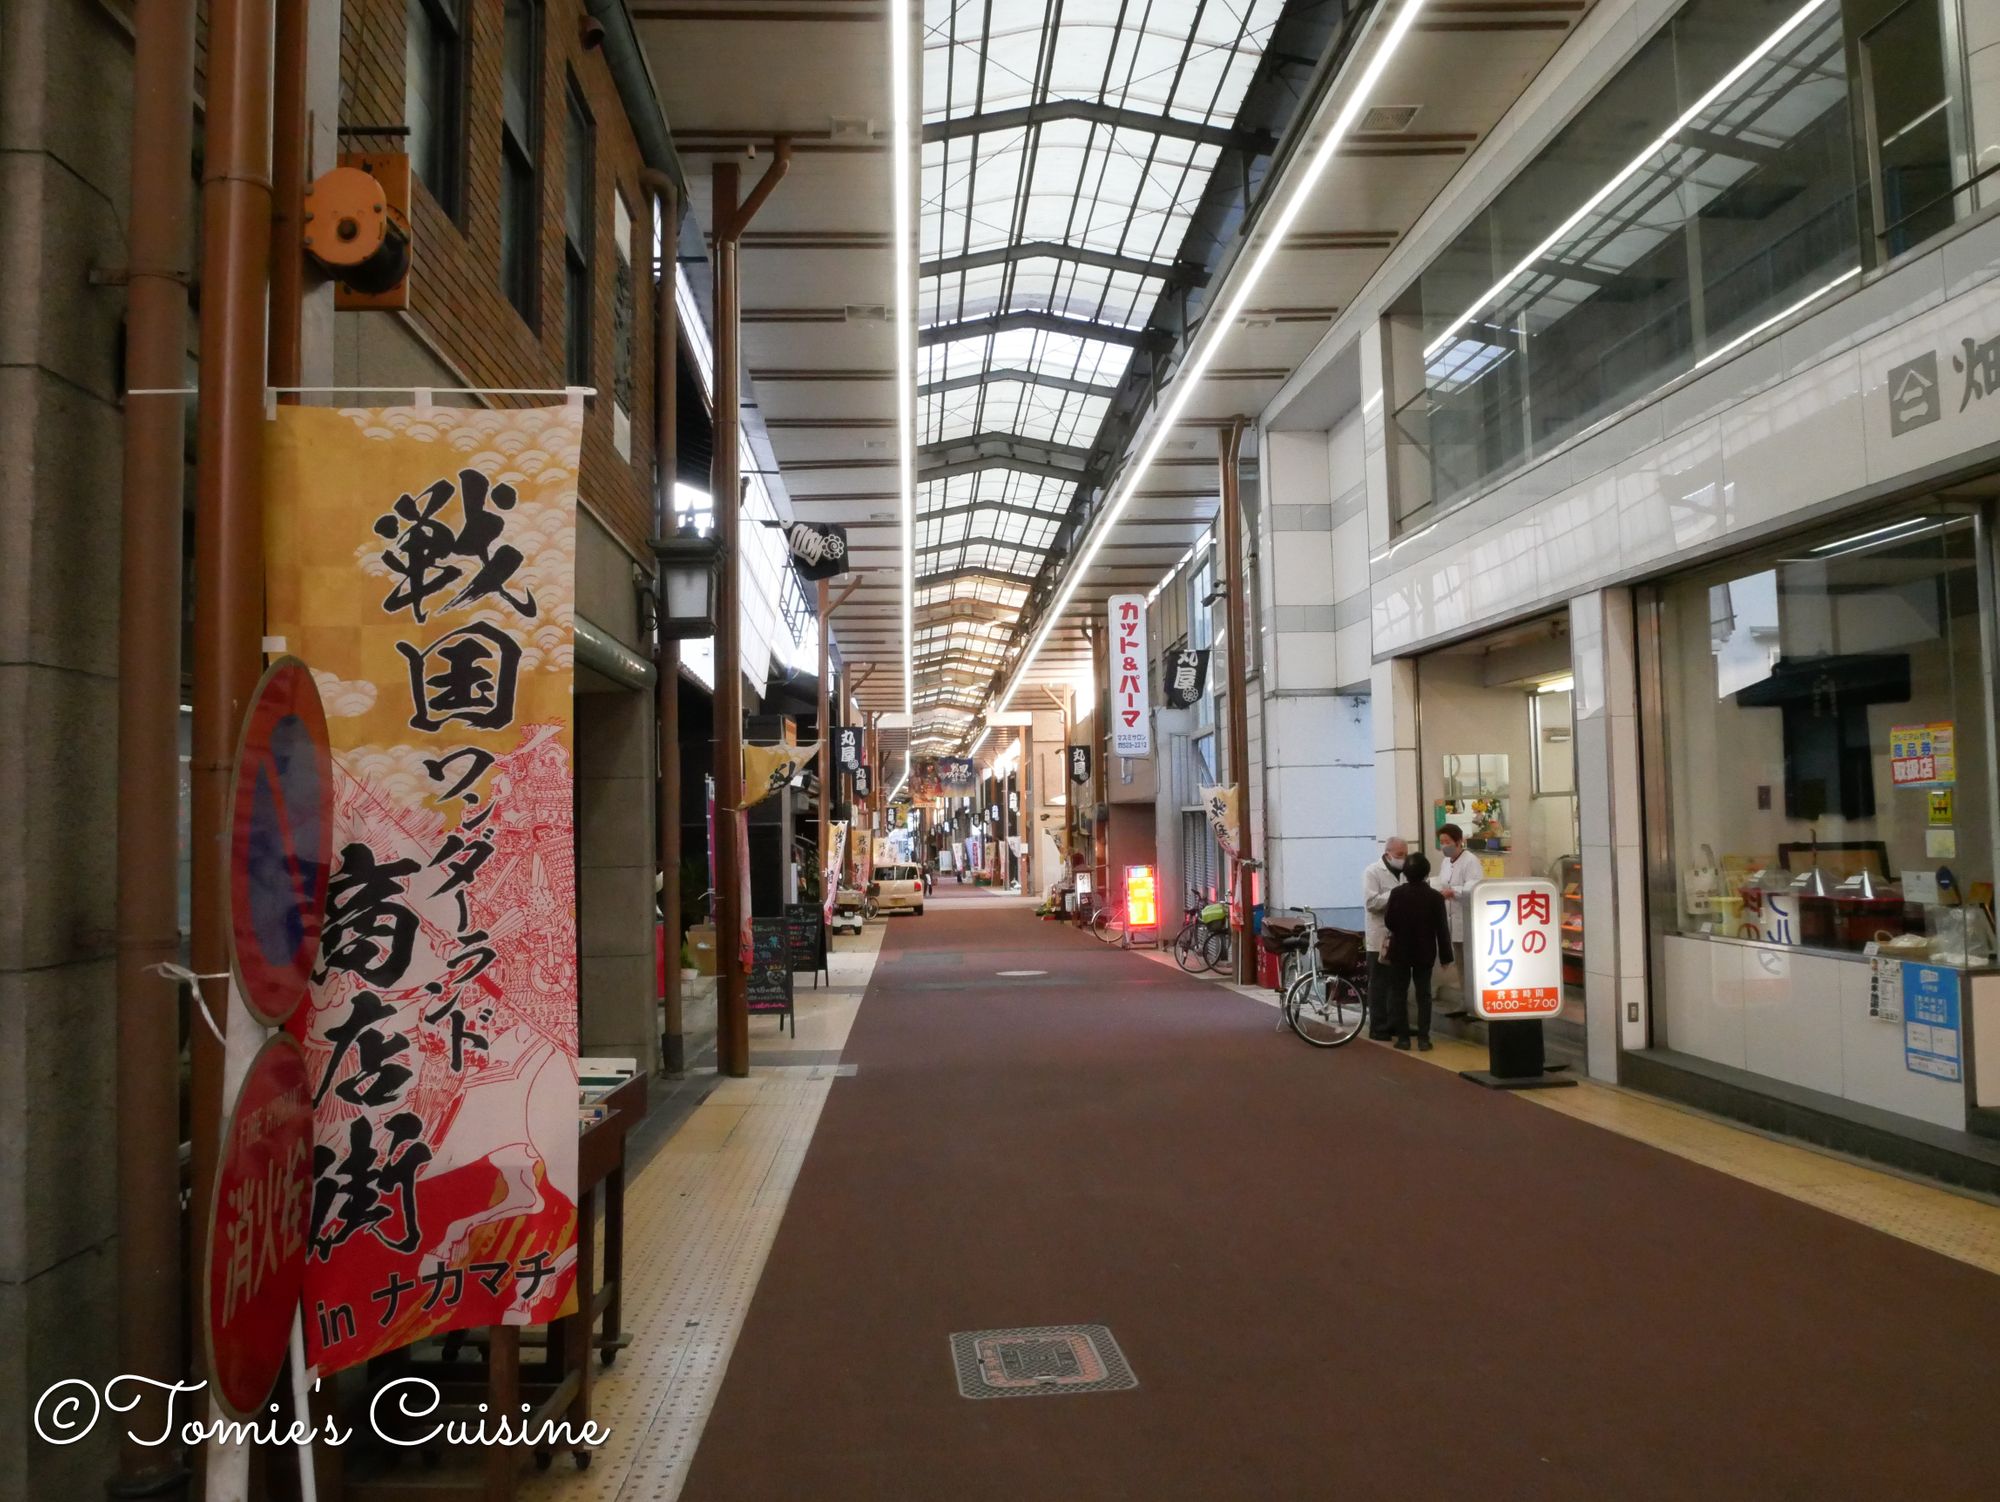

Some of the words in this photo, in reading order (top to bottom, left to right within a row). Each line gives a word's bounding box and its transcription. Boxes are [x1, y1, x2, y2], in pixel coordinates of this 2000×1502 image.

[1485, 898, 1515, 987] フルタ
[1516, 889, 1550, 955] 肉の
[223, 1137, 306, 1328] 消火栓
[316, 1300, 356, 1349] in
[371, 1249, 557, 1329] ナカマチ
